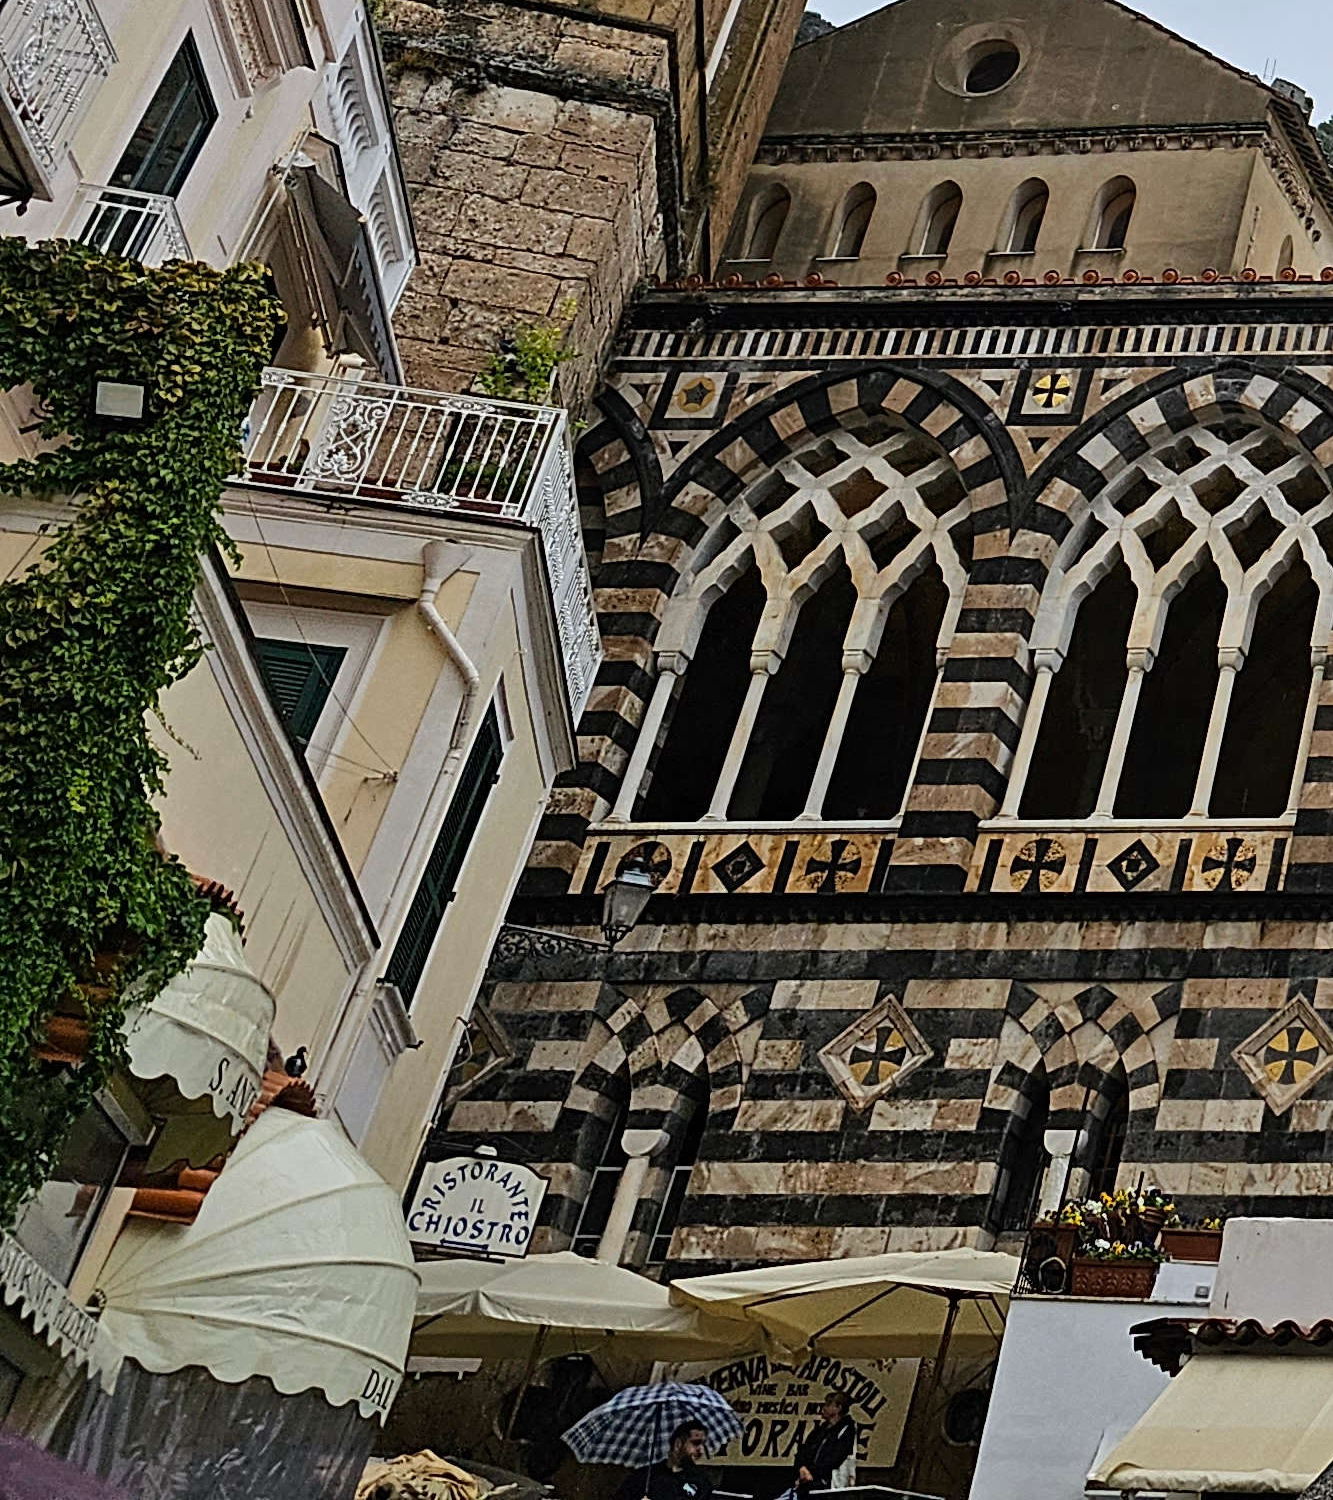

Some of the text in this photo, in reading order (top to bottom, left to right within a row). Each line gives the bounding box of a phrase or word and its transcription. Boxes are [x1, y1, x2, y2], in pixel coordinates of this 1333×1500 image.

[421, 1161, 529, 1222] RISTORANTE
[470, 1198, 485, 1214] IL
[408, 1211, 530, 1246] CHIOSTRO
[360, 1368, 394, 1410] DAL
[797, 1354, 887, 1419] APOSTOLI
